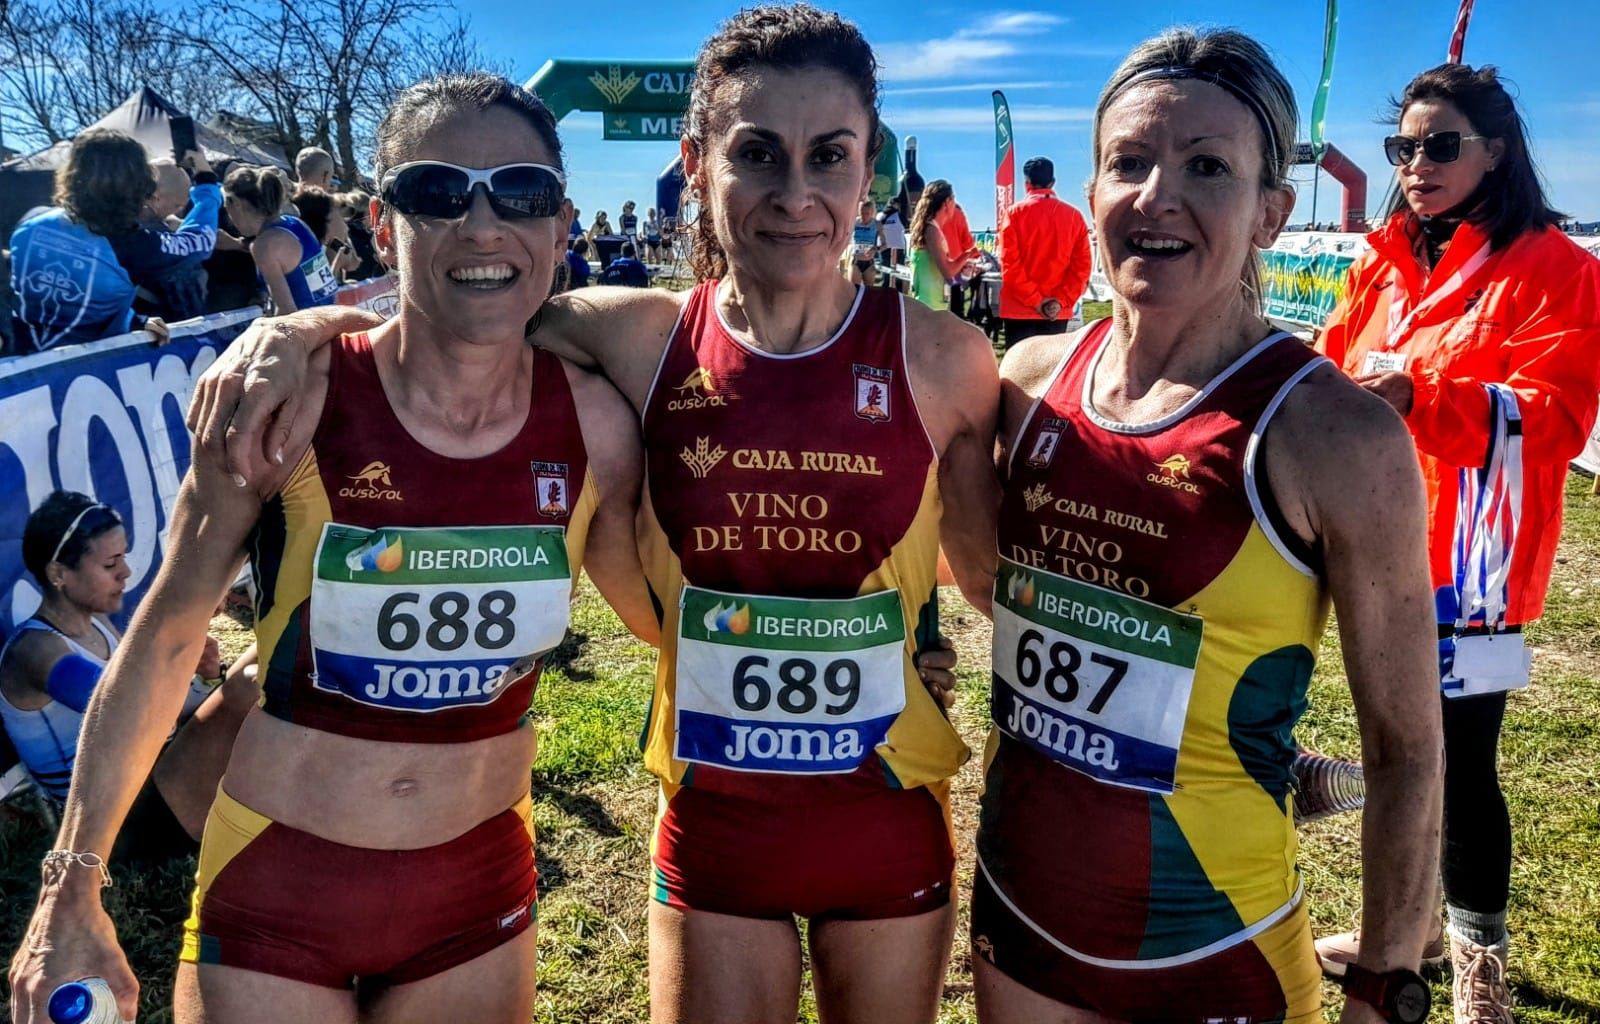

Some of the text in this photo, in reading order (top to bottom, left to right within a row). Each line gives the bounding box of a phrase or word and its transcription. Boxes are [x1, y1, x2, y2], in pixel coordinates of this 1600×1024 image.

[641, 117, 684, 135] ME
[668, 395, 728, 411] austral
[732, 449, 883, 476] CAJA RURAL
[339, 487, 403, 500] austral
[1146, 473, 1200, 494] austral
[727, 492, 828, 520] VINO
[1055, 498, 1168, 539] CAJA RURAL
[693, 526, 862, 553] DE TORO
[1040, 525, 1122, 563] VINO
[409, 545, 549, 570] IBERDROLA
[1012, 544, 1150, 598] DE TORO
[377, 590, 516, 651] 688
[756, 613, 888, 638] IBERDROLA
[1037, 591, 1172, 647] IBERDROLA
[732, 655, 861, 715] 689
[1016, 629, 1129, 715] 687
[724, 725, 864, 762] Joma
[1008, 695, 1119, 771] Joma
